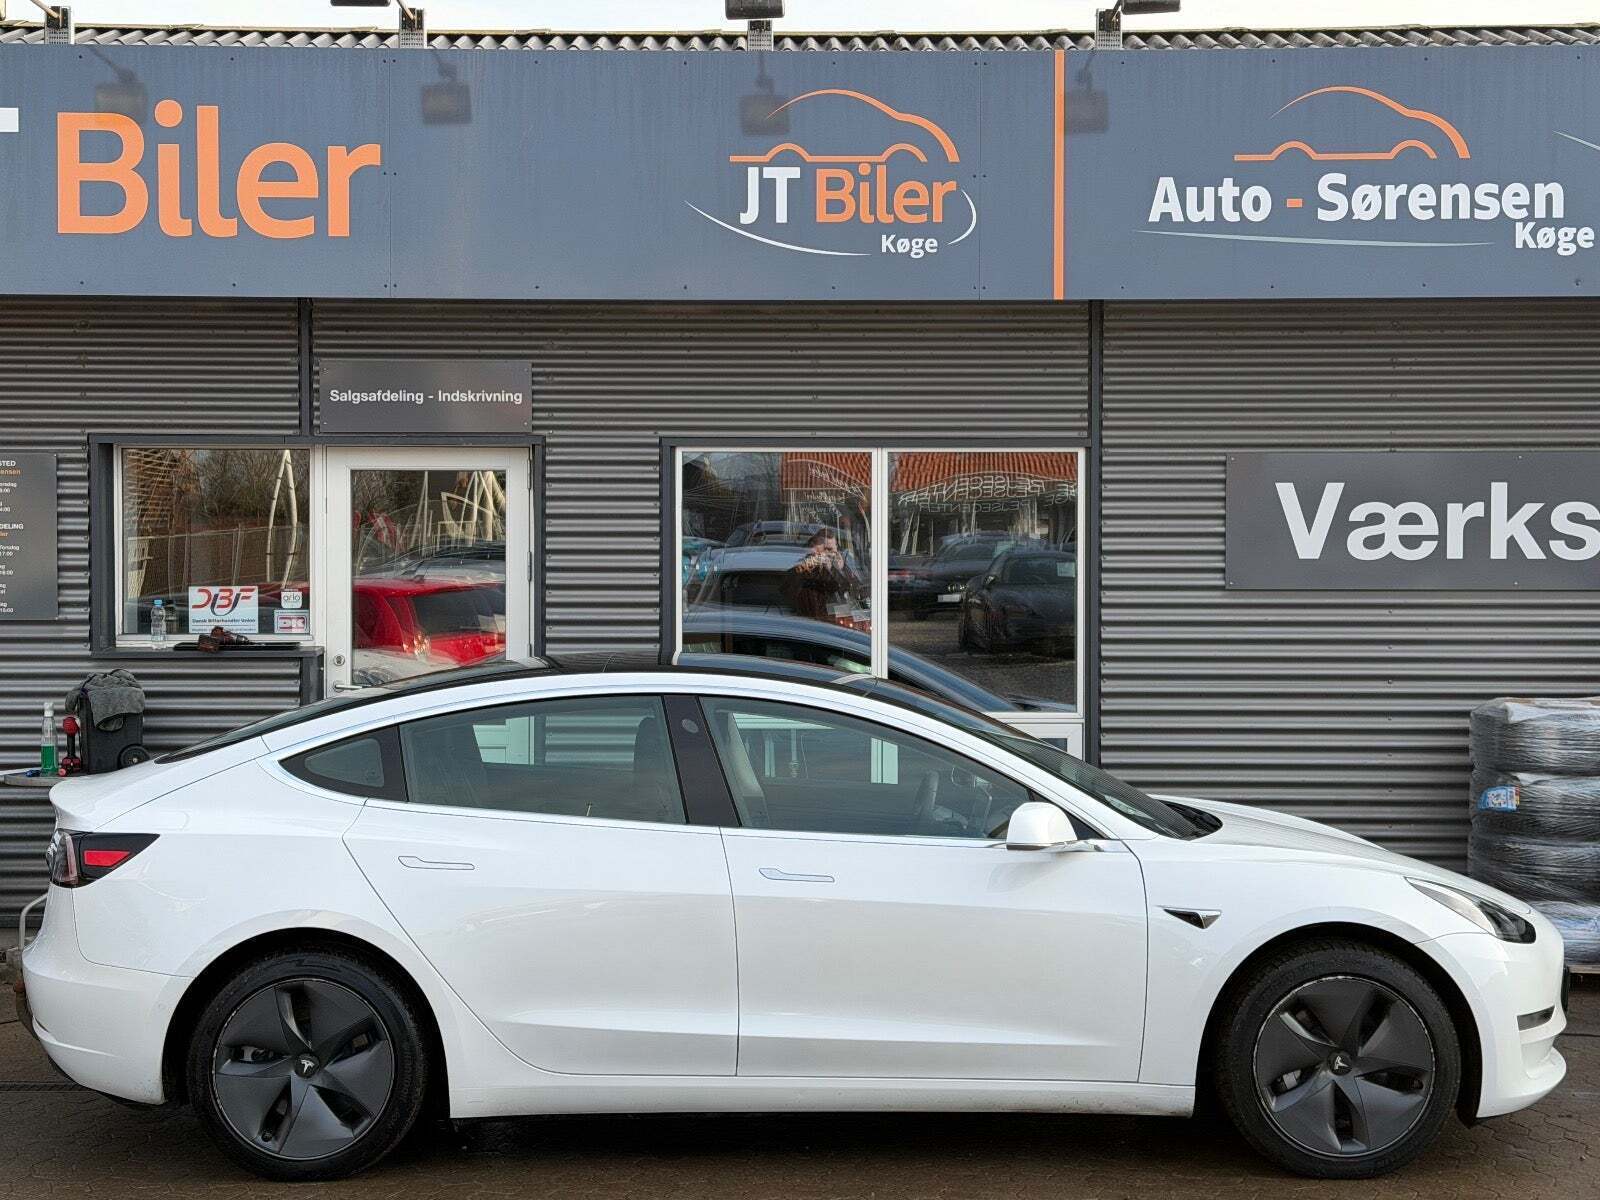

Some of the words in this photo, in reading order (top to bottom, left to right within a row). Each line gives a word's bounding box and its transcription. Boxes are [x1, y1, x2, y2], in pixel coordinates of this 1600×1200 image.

[57, 99, 381, 239] Biler
[739, 166, 801, 225] JT
[815, 162, 957, 224] Biler
[1148, 176, 1272, 222] Auto
[1317, 172, 1565, 221] Sørensen
[881, 234, 938, 259] Køge
[1515, 221, 1595, 256] Køge
[329, 389, 424, 405] Salgsafdeling
[438, 389, 523, 405] Indskrivning
[1275, 481, 1600, 561] Værks
